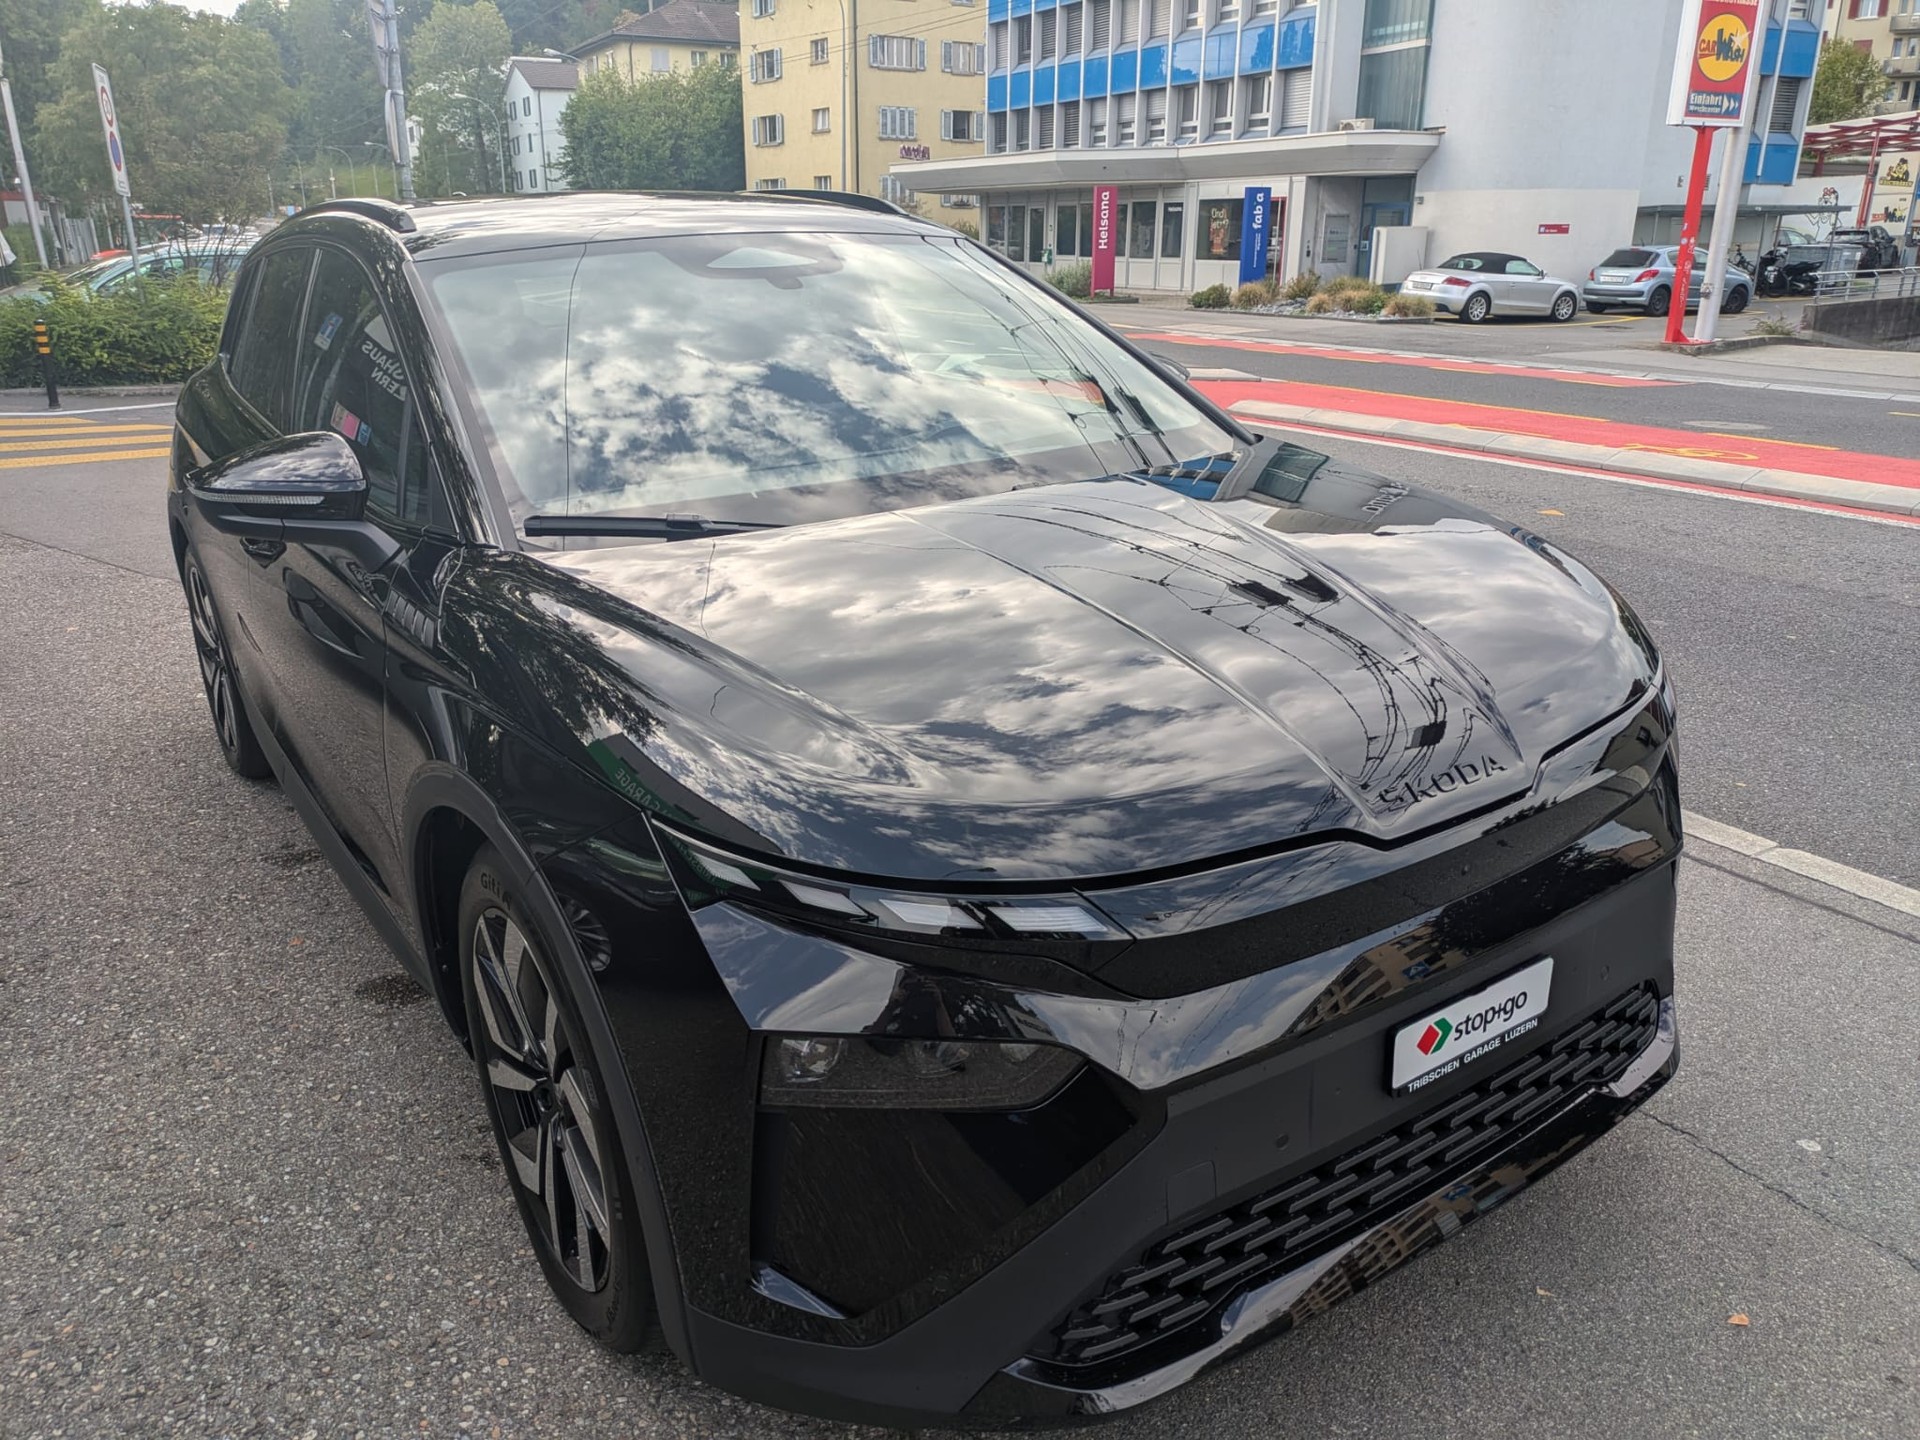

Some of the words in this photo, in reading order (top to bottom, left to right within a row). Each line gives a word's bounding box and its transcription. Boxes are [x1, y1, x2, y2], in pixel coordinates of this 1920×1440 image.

[1690, 92, 1723, 106] Einfahrt
[1098, 191, 1110, 249] Helsana
[1453, 990, 1528, 1042] stop+go
[1407, 1059, 1461, 1093] TRIBSCHEN
[1463, 1036, 1501, 1064] GARAGE
[1504, 1018, 1538, 1042] LUZERN
